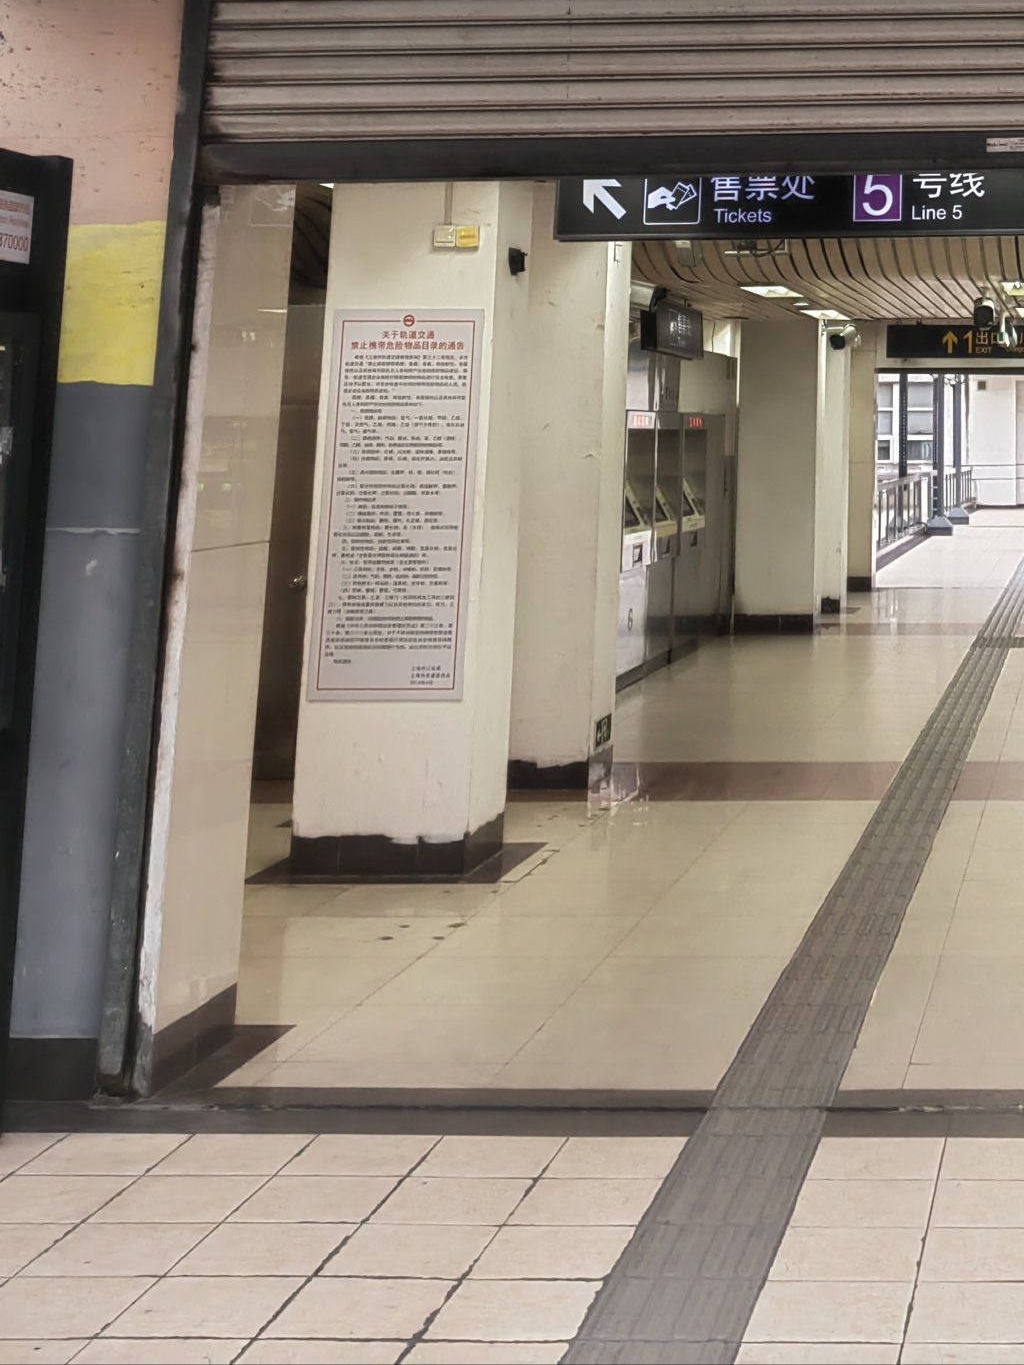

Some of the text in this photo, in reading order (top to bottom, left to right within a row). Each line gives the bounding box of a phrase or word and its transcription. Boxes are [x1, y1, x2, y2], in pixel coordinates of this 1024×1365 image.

[710, 175, 815, 202] 售票处
[862, 172, 986, 216] 5 号线
[714, 208, 772, 223] Tickets
[911, 204, 963, 221] Line 5
[382, 330, 435, 340] 关于轨道交通
[963, 330, 973, 353] 1
[976, 346, 992, 354] EXIT
[627, 608, 633, 631] 6
